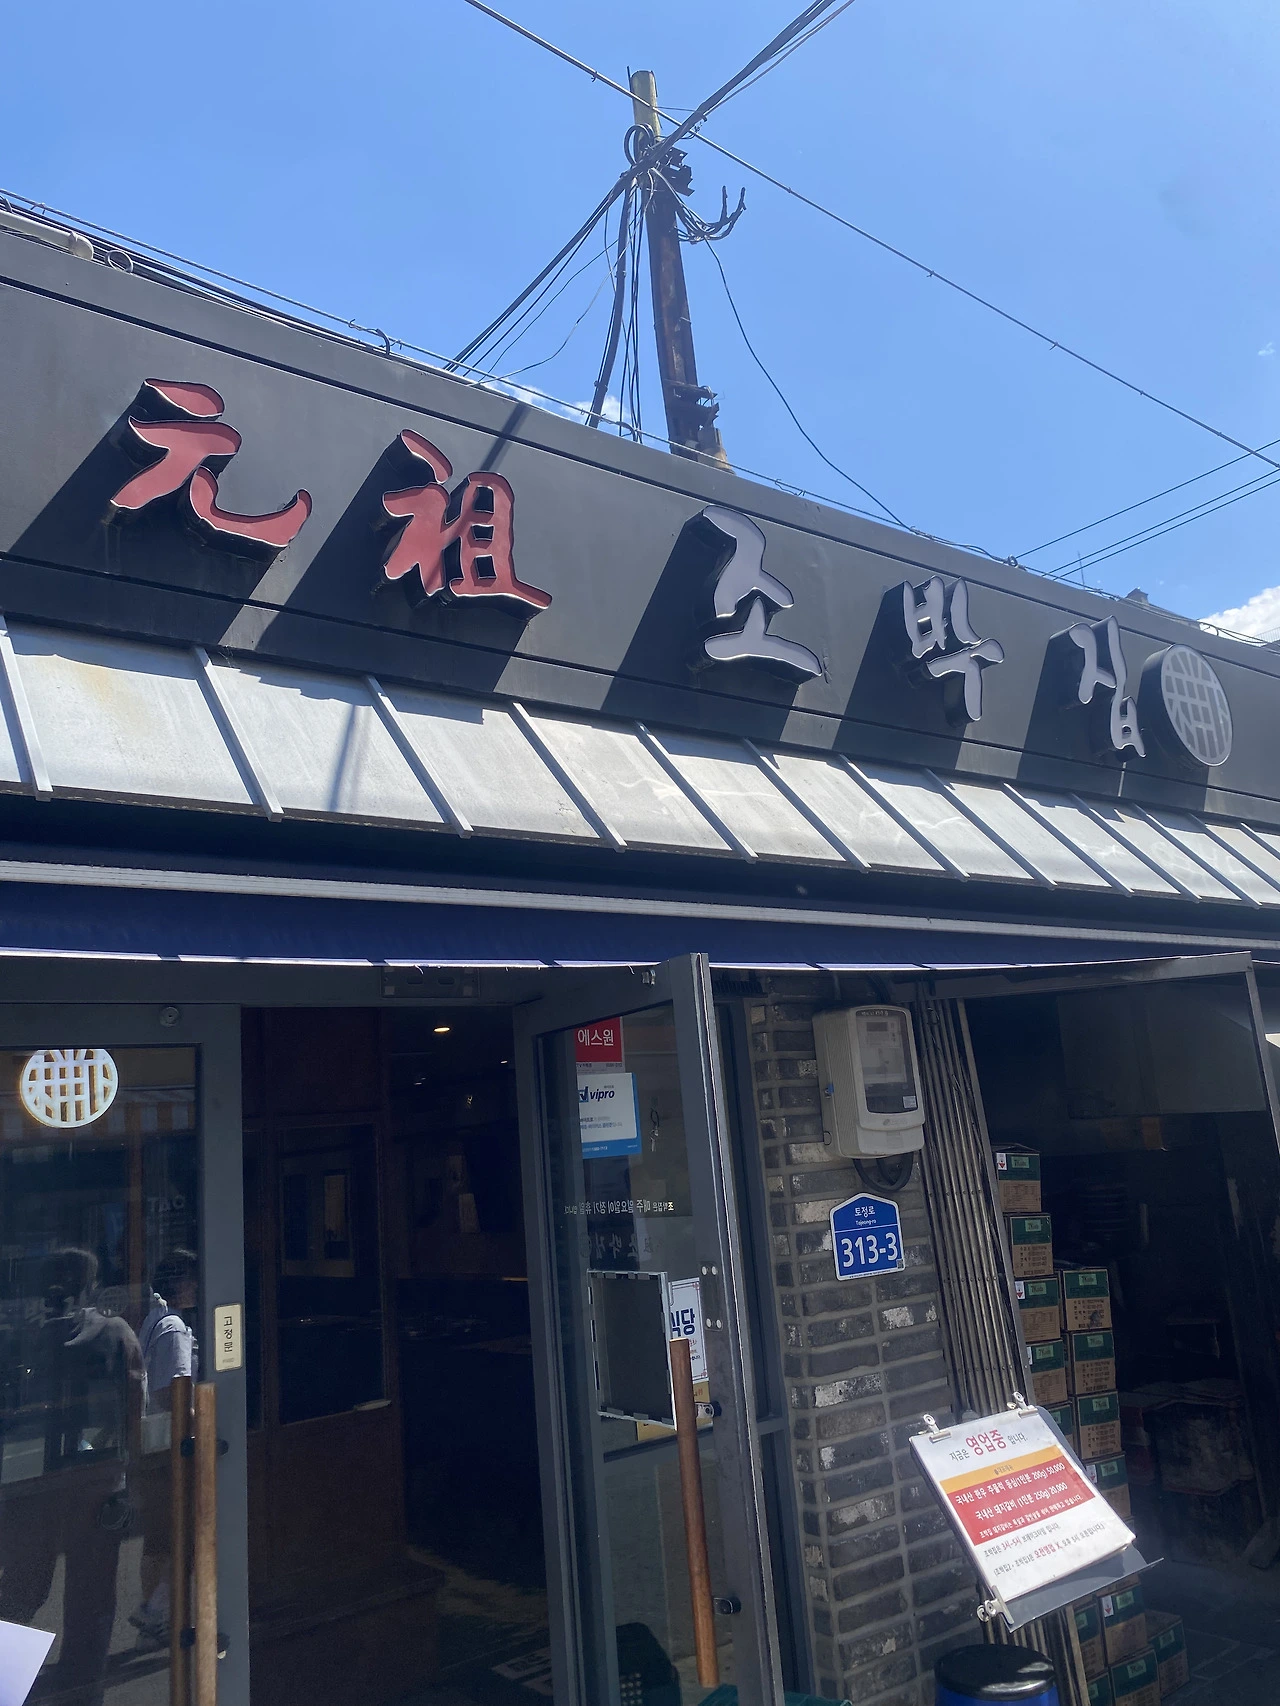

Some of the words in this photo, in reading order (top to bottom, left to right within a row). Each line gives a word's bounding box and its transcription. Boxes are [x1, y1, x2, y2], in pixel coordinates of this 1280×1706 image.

[110, 378, 553, 610] 元祖
[703, 505, 1147, 759] 조박집
[577, 1028, 615, 1046] 에스원
[589, 1089, 615, 1102] vipro
[854, 1205, 876, 1218] 토정로
[841, 1232, 898, 1267] 313-3
[223, 1315, 234, 1353] 고정문
[949, 1448, 971, 1462] 지금은
[965, 1429, 1008, 1456] 영업중
[1007, 1431, 1028, 1446] 입니다.
[956, 1491, 975, 1505] 국내산
[975, 1487, 987, 1499] 한우
[989, 1481, 1003, 1495] 주물럭
[1033, 1468, 1047, 1479] 200g)
[1047, 1462, 1065, 1475] 50,000
[976, 1506, 995, 1520] 국내산
[995, 1500, 1016, 1514] 돼지갈비
[1033, 1488, 1049, 1501] 250g)
[1049, 1482, 1068, 1495] 20,000
[979, 1528, 993, 1538] 조박집
[984, 1544, 1001, 1557] 조박집은
[1034, 1543, 1055, 1558] 오전영업
